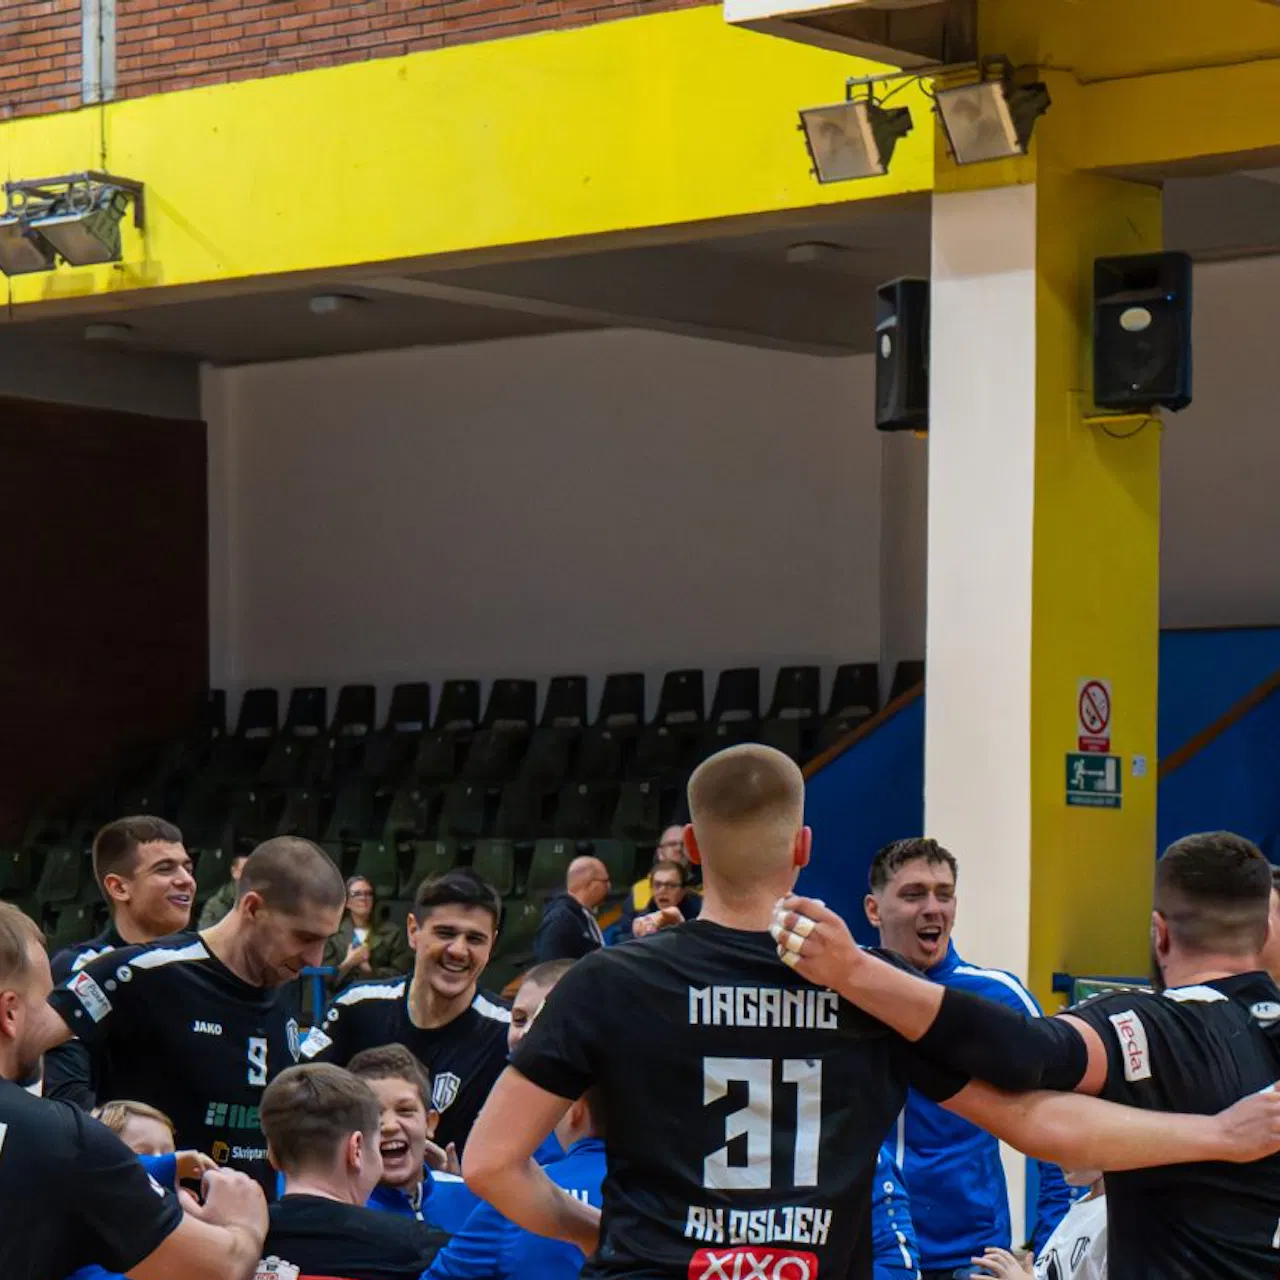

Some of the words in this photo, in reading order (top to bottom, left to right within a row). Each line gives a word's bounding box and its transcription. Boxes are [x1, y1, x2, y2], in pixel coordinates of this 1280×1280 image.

[193, 1019, 223, 1036] JAKO
[247, 1037, 268, 1086] 9
[702, 1056, 822, 1189] 31
[684, 1206, 724, 1244] RK
[729, 1206, 833, 1245] OSIJEK
